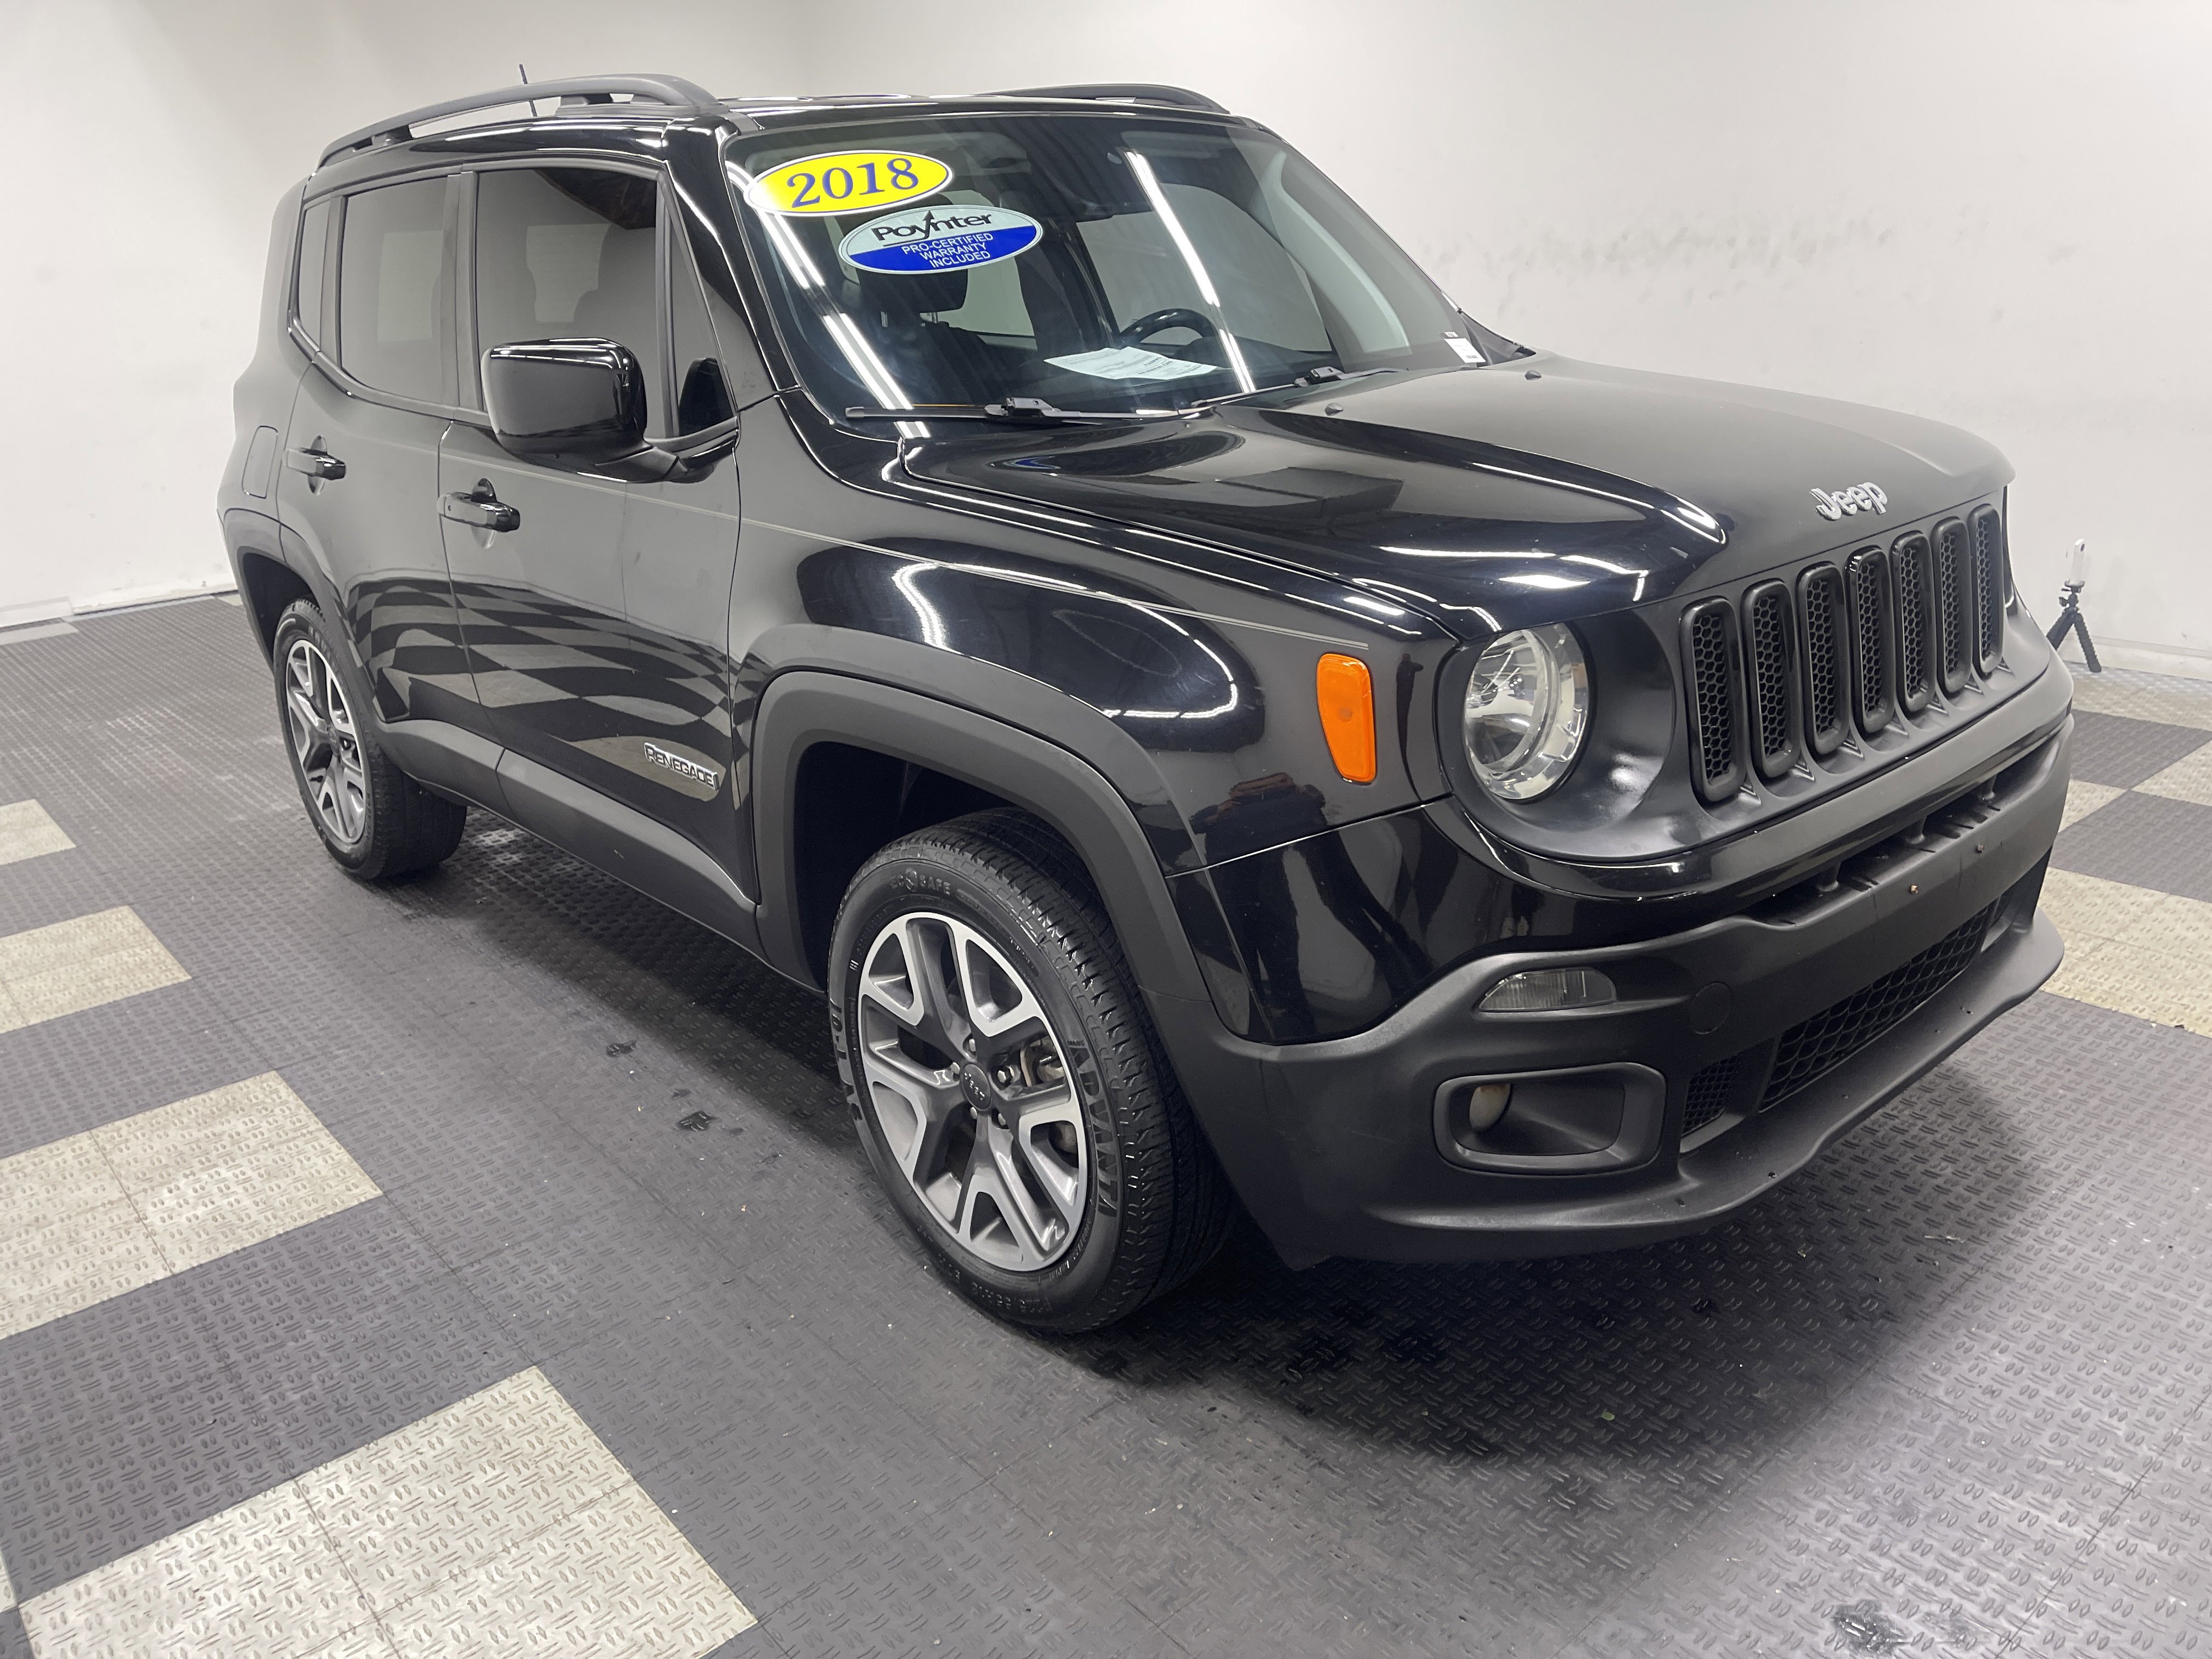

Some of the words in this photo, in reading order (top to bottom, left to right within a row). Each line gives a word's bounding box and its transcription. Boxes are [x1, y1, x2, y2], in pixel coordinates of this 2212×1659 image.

[786, 158, 919, 208] 2018
[871, 211, 992, 242] Poynter
[901, 233, 994, 255] PRO-CERTIFIED
[920, 242, 987, 261] WARRANTY
[929, 251, 991, 268] INCLUDED
[1809, 482, 1888, 521] Jeep
[645, 743, 716, 790] RENEGADE
